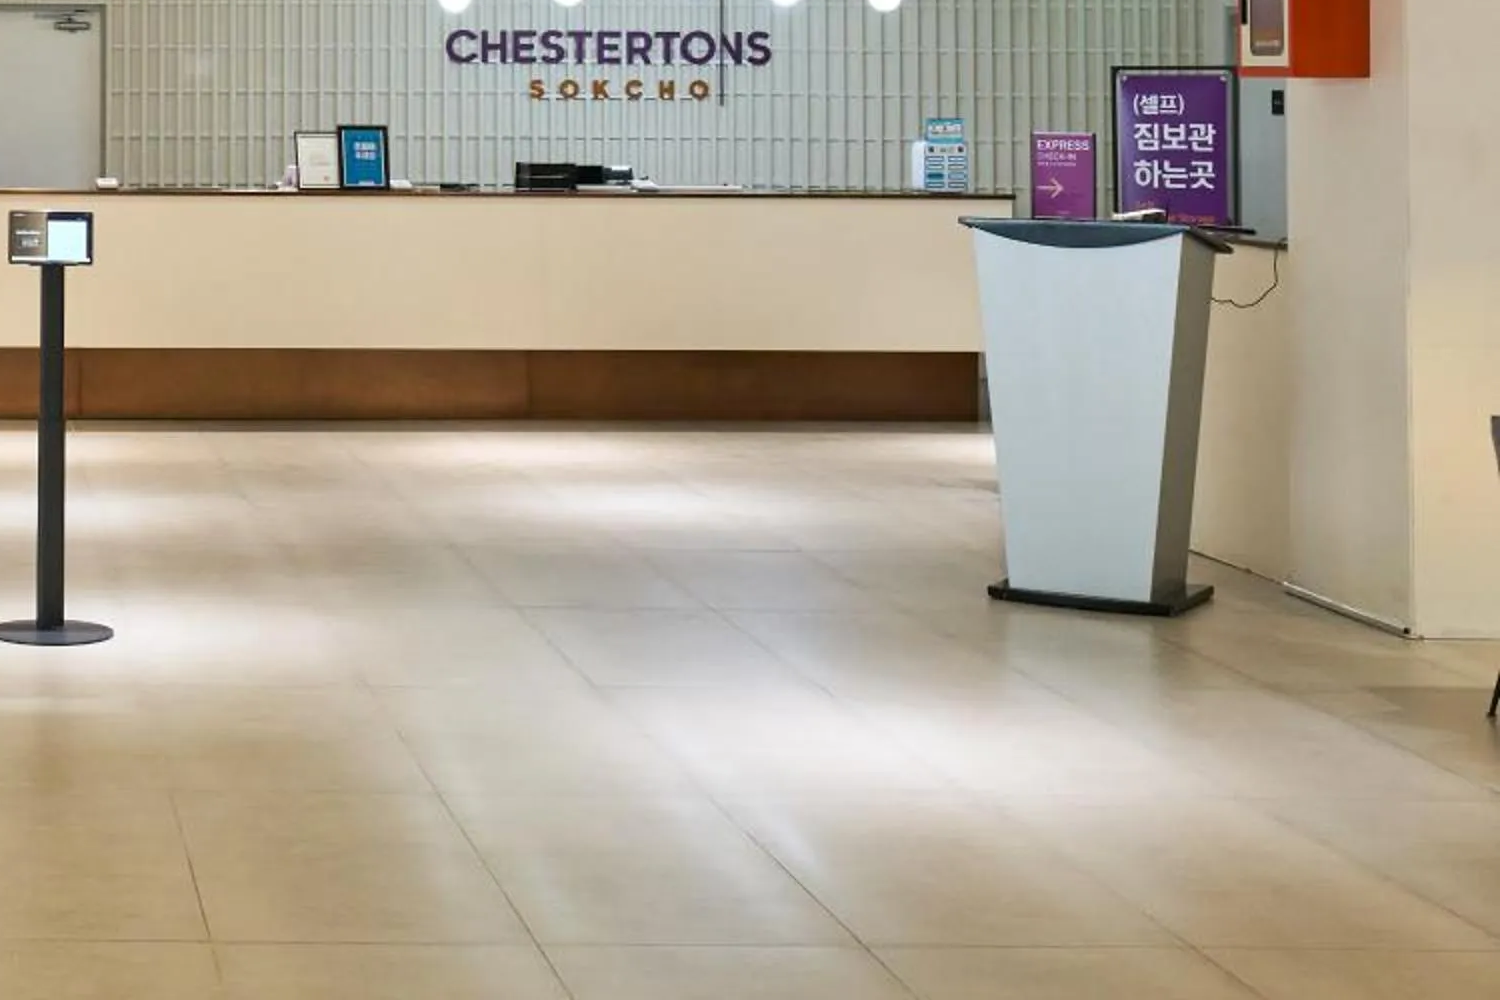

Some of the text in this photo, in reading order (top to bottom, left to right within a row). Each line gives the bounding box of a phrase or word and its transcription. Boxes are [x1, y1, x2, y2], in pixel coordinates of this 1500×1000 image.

[445, 29, 773, 66] CHESTERTONS
[529, 79, 710, 101] SOKCHO
[1133, 93, 1185, 116] (셀프)
[1036, 139, 1090, 151] EXPRESS
[1133, 123, 1217, 152] 짐보관
[1133, 159, 1216, 189] 하는곳
